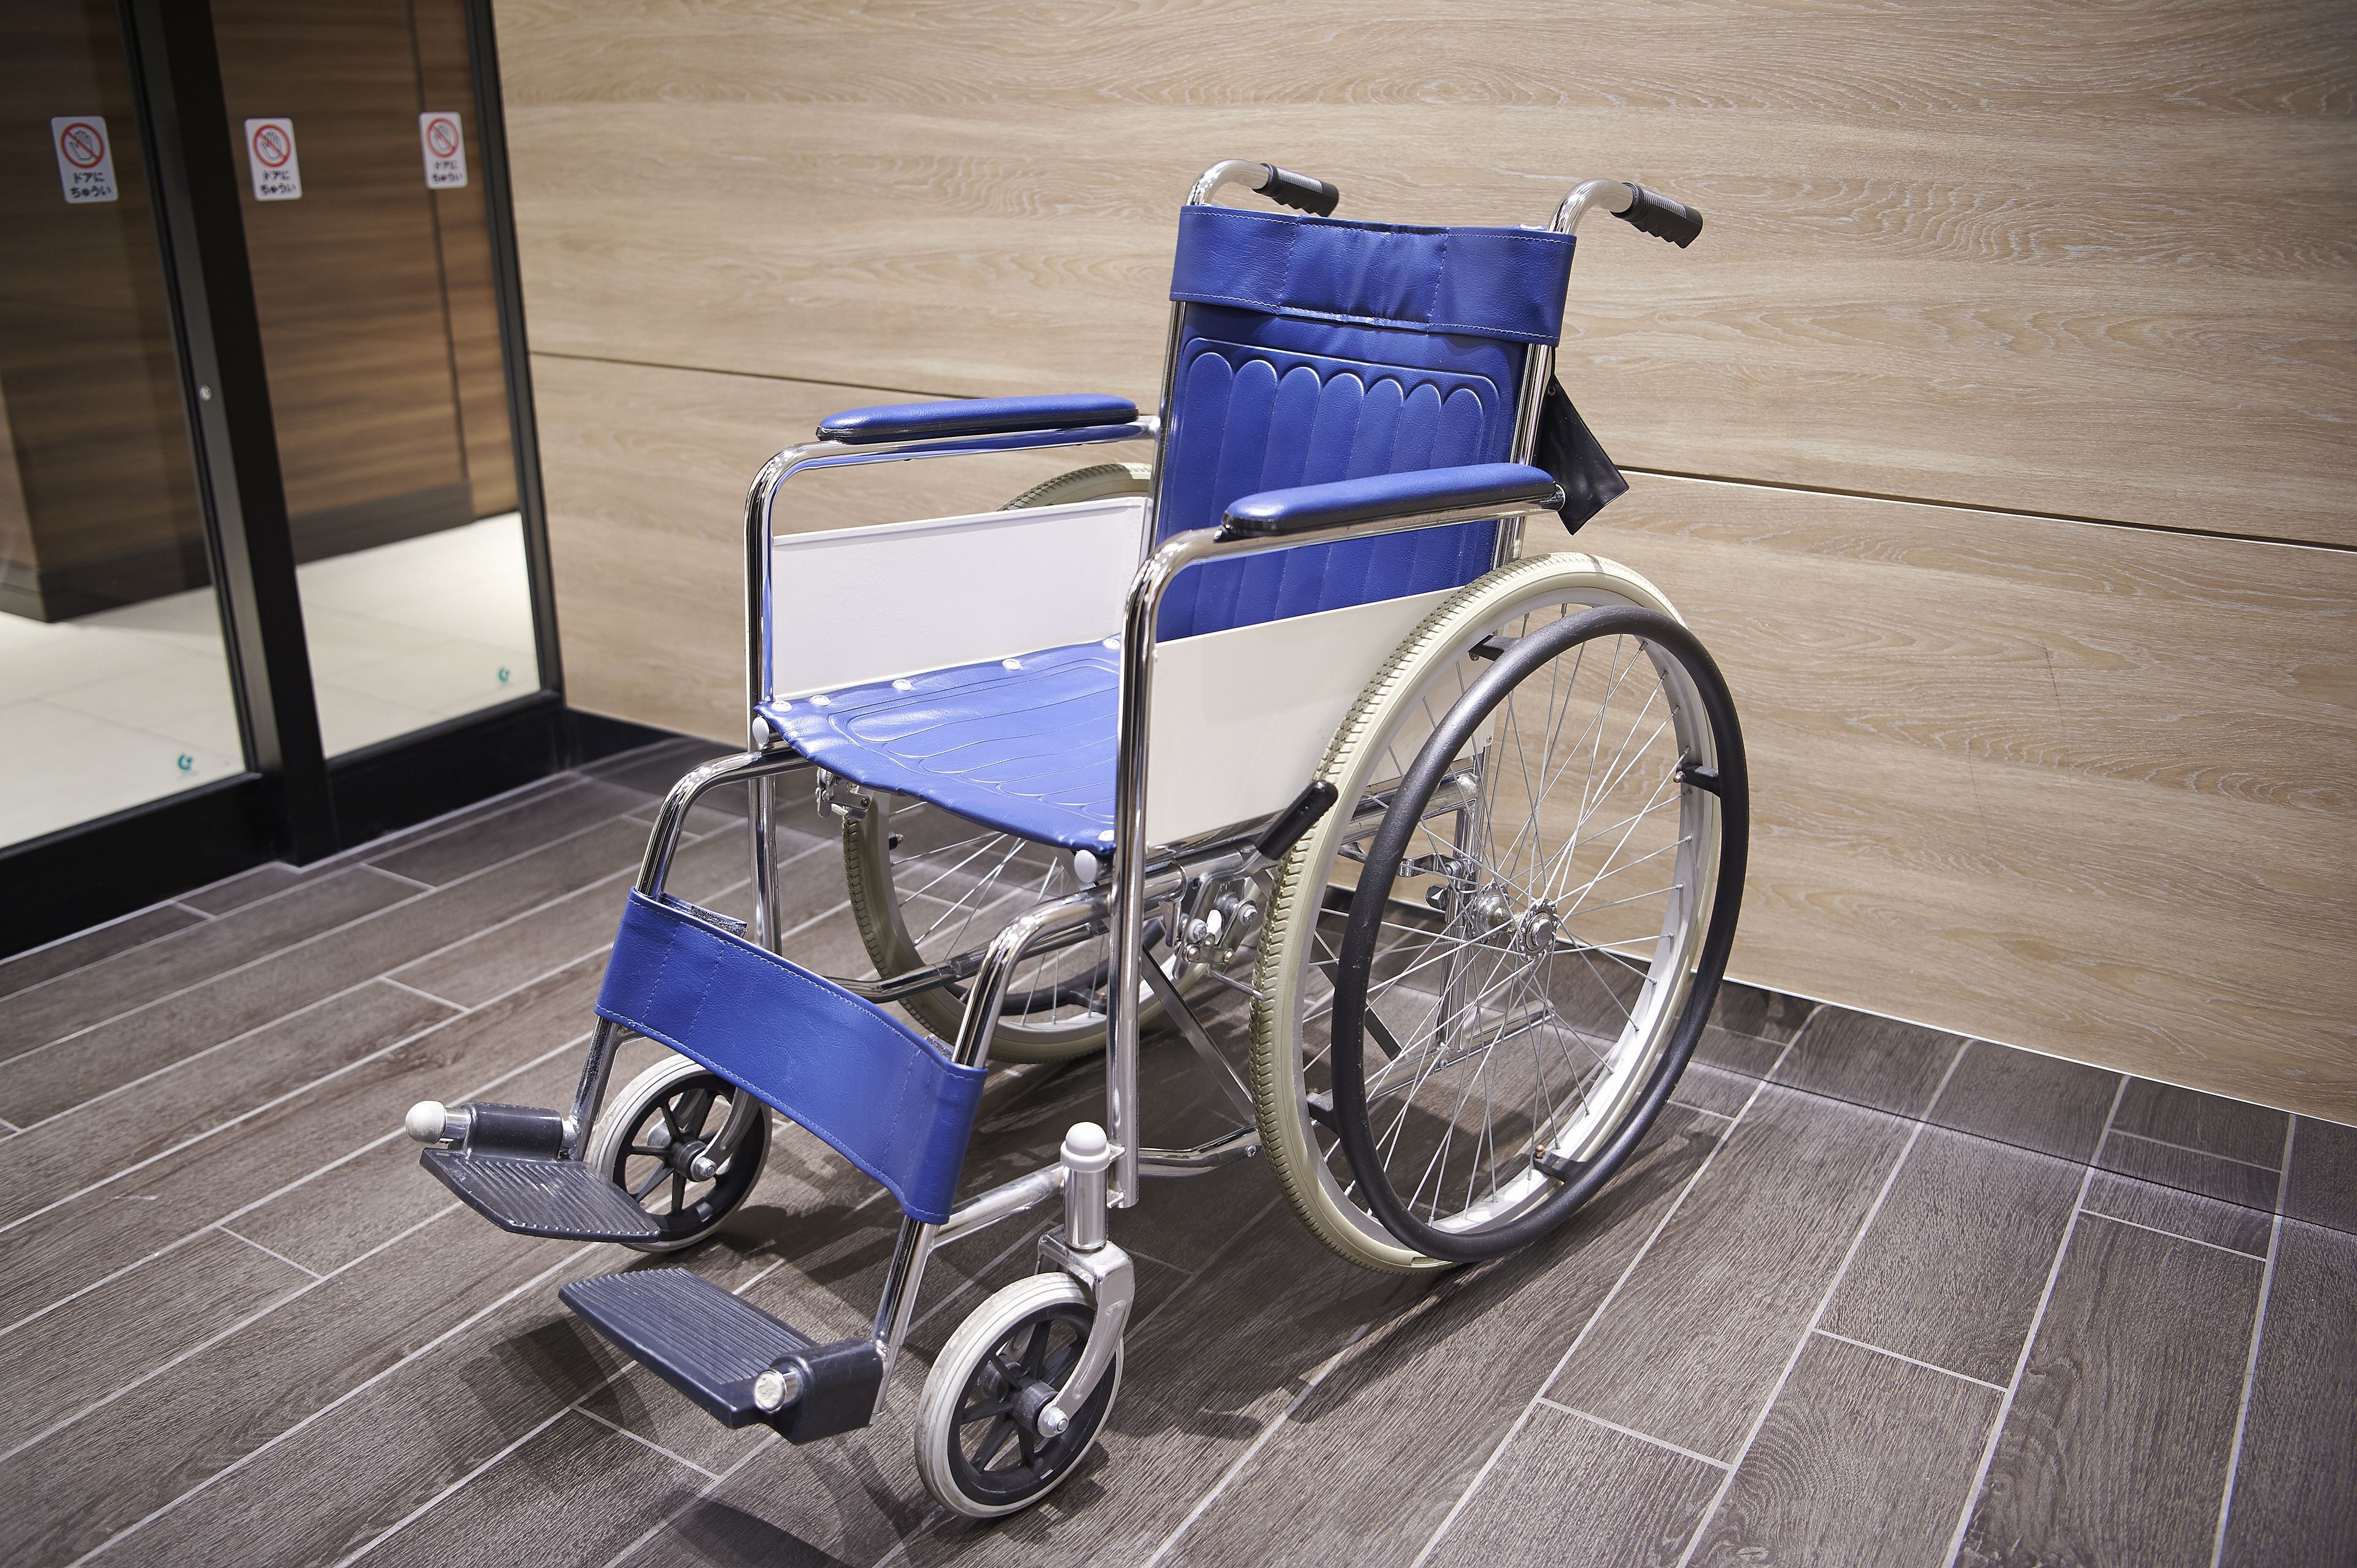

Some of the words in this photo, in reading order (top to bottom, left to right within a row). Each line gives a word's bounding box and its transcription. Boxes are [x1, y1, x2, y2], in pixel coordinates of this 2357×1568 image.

[73, 171, 105, 183] ドアに
[263, 169, 290, 181] ドアに
[69, 185, 112, 198] ちゅうい
[260, 182, 296, 196] ちゅうい
